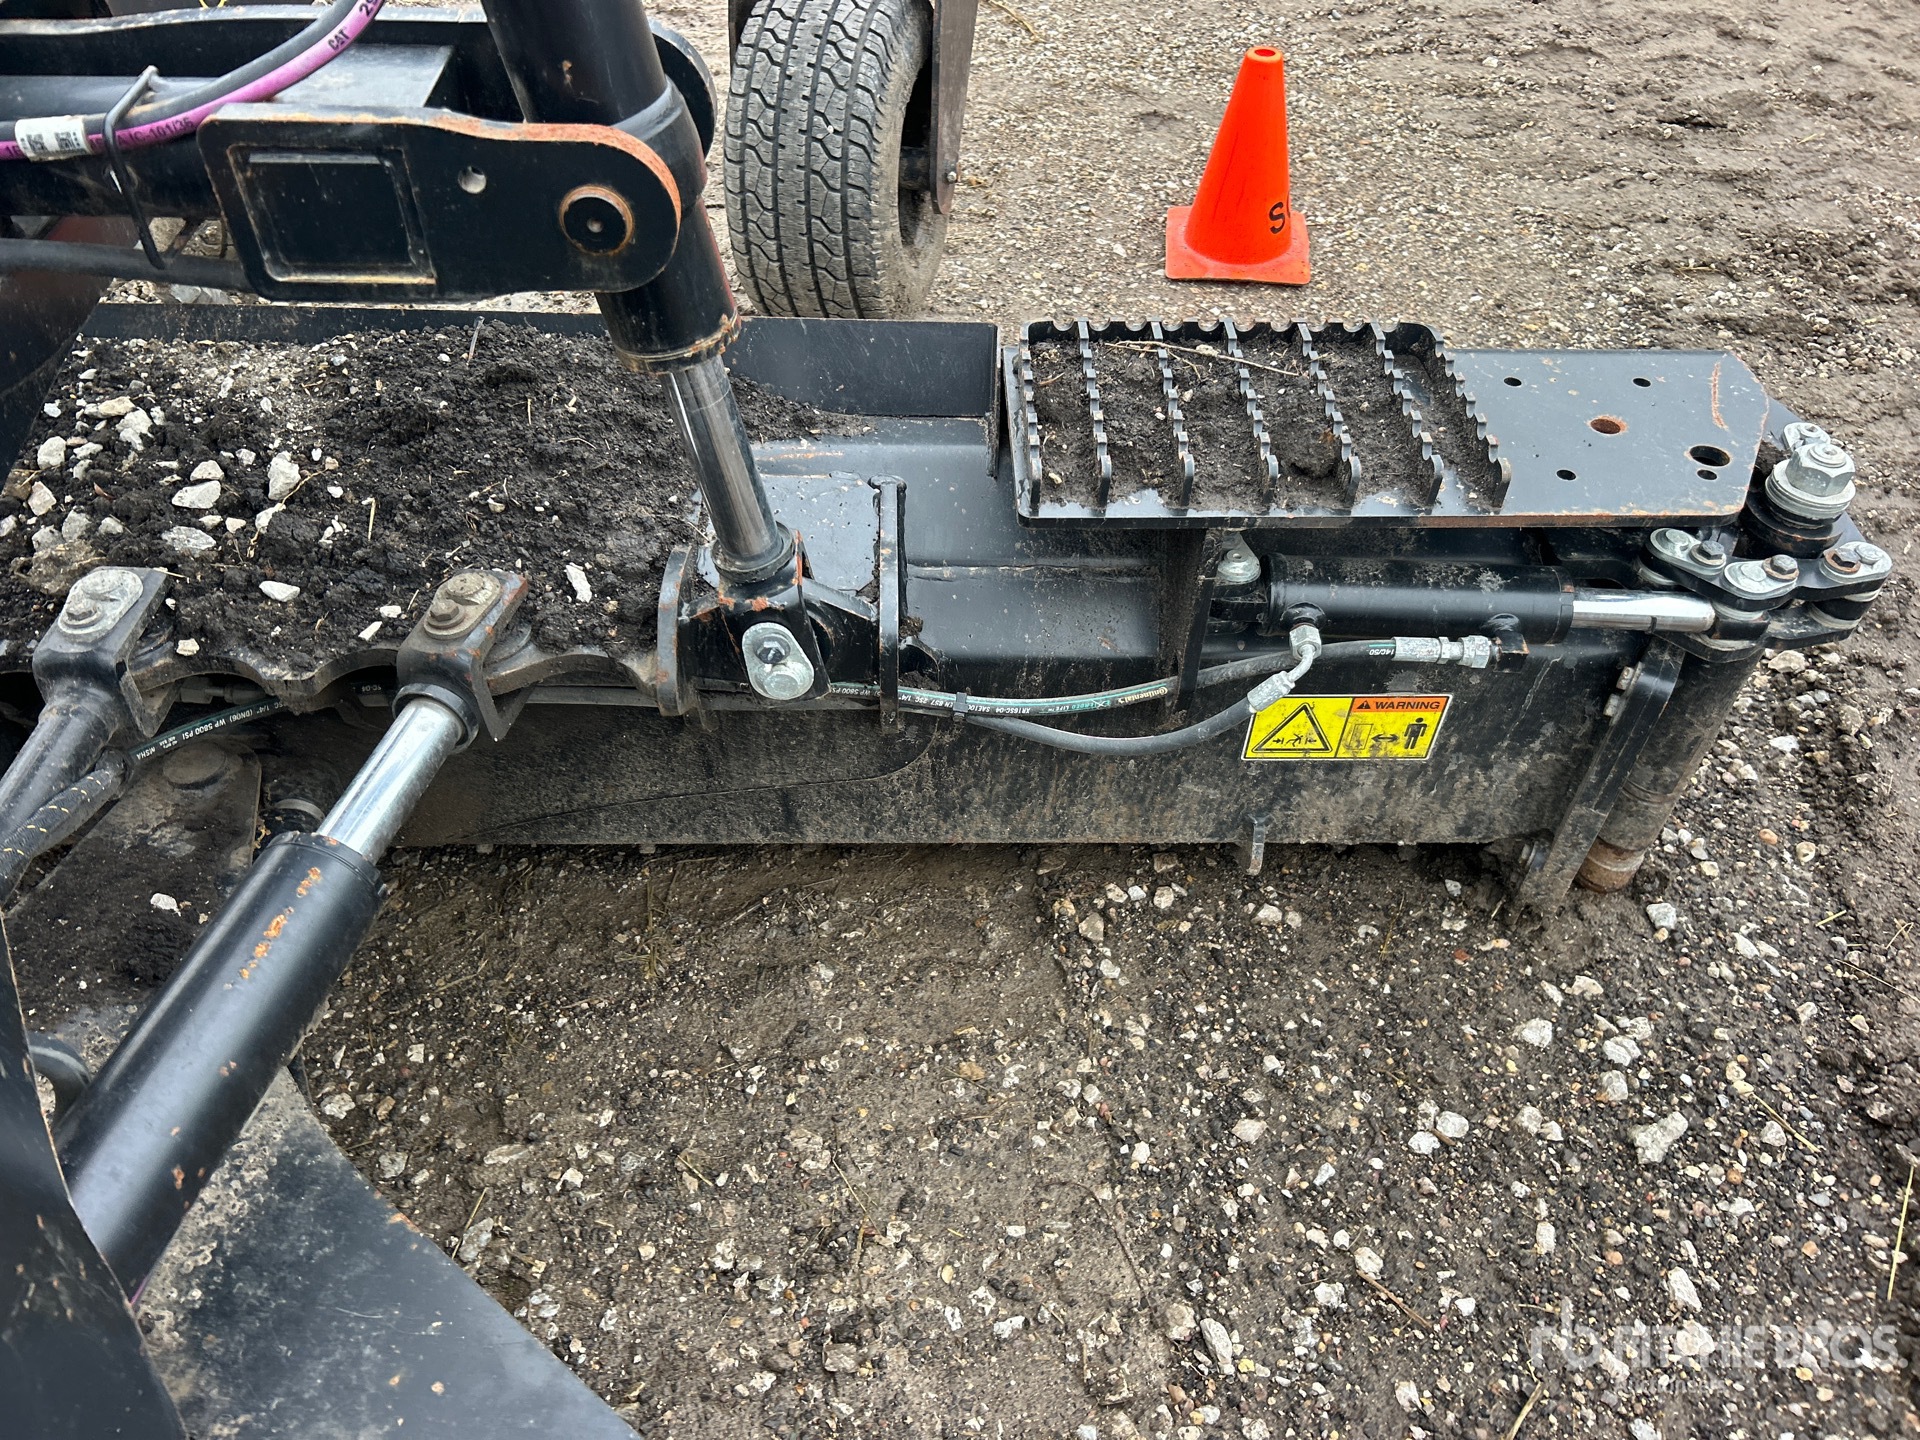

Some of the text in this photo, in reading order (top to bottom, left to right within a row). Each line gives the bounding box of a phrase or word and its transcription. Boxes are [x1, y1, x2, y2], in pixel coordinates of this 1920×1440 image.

[328, 28, 349, 52] CAT
[1124, 686, 1168, 704] Continental
[1375, 701, 1440, 710] WARNING
[194, 722, 213, 736] 5800
[214, 718, 226, 729] WP
[181, 730, 194, 741] PSI
[136, 746, 156, 760] MSHA
